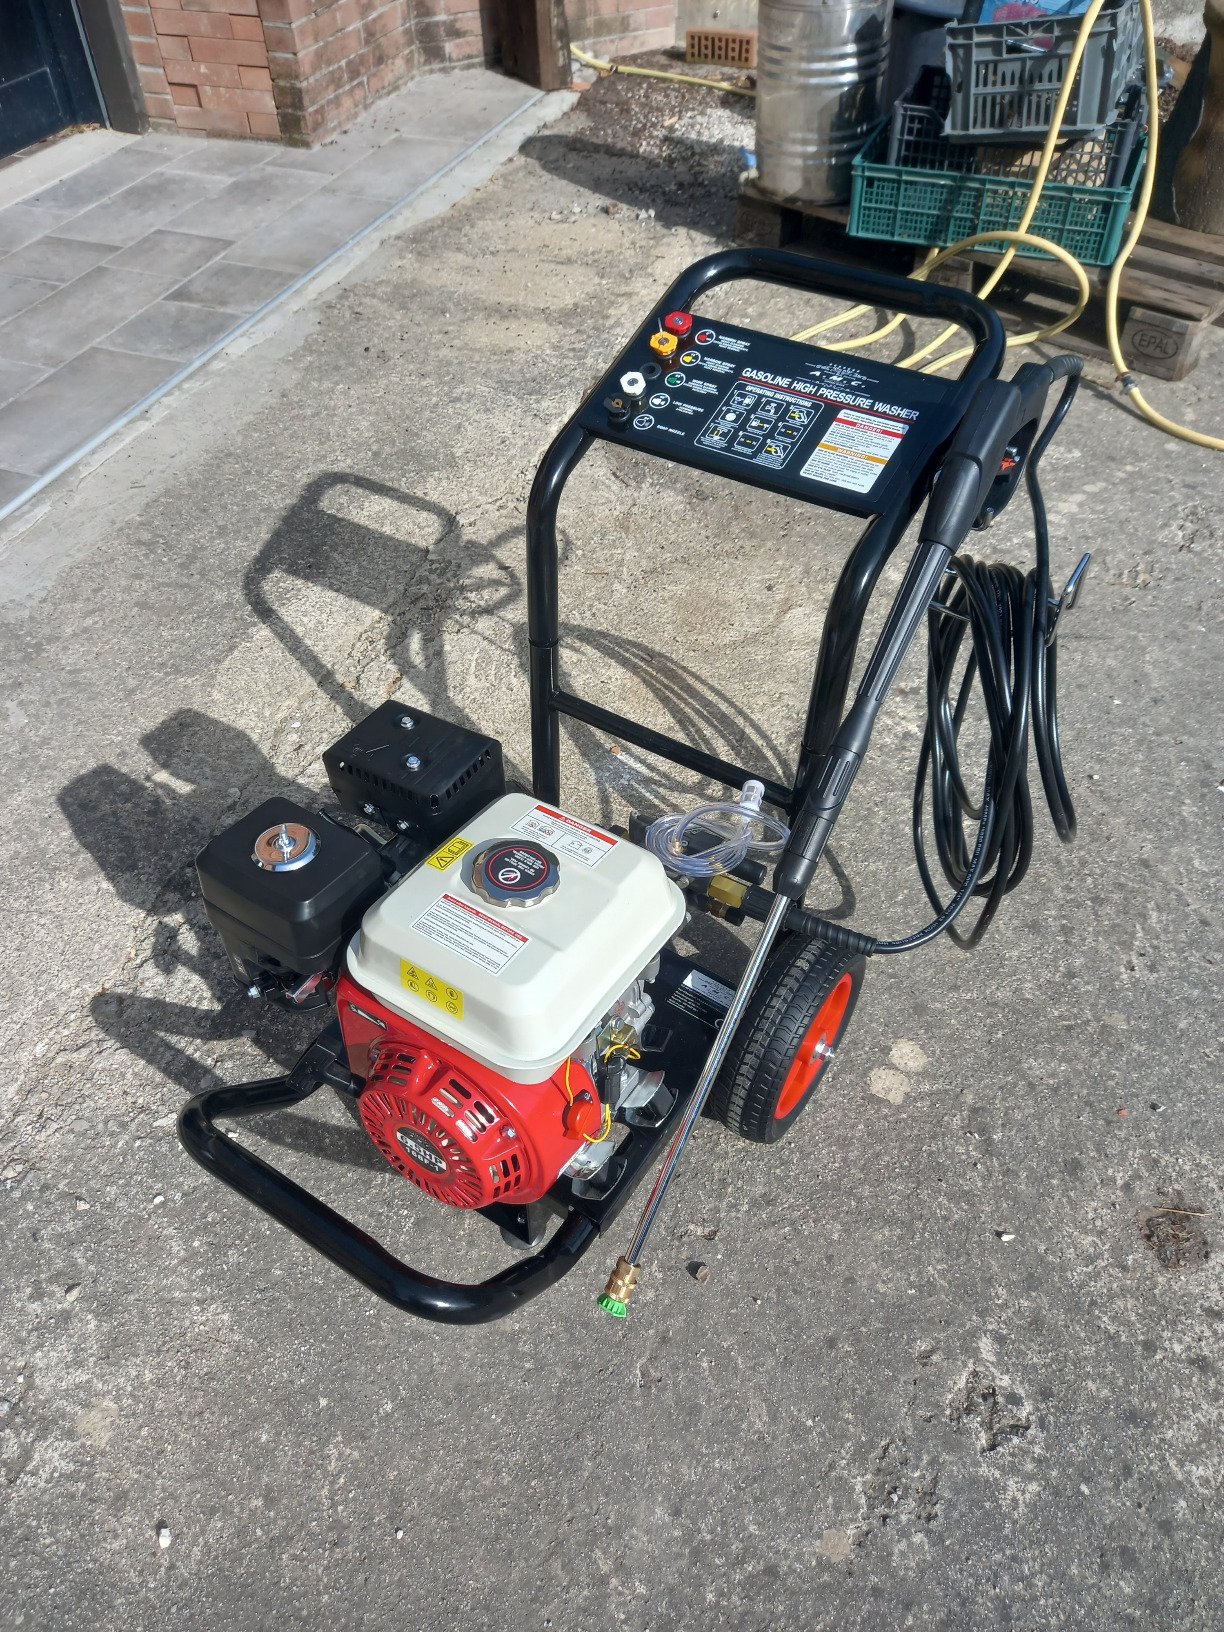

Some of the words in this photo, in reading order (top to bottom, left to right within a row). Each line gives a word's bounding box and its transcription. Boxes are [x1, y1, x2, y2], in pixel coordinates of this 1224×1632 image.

[1138, 333, 1169, 355] EPAL
[741, 367, 792, 388] GASOLINE
[790, 380, 818, 395] HIGH
[816, 387, 874, 409] PRESSURE
[873, 401, 920, 421] WASHER
[745, 385, 775, 397] OPERATING
[773, 392, 813, 408] INSTRUCTIONS
[855, 423, 883, 434] DANGER!
[836, 447, 868, 460] WARNING!
[565, 819, 592, 834] DANGER
